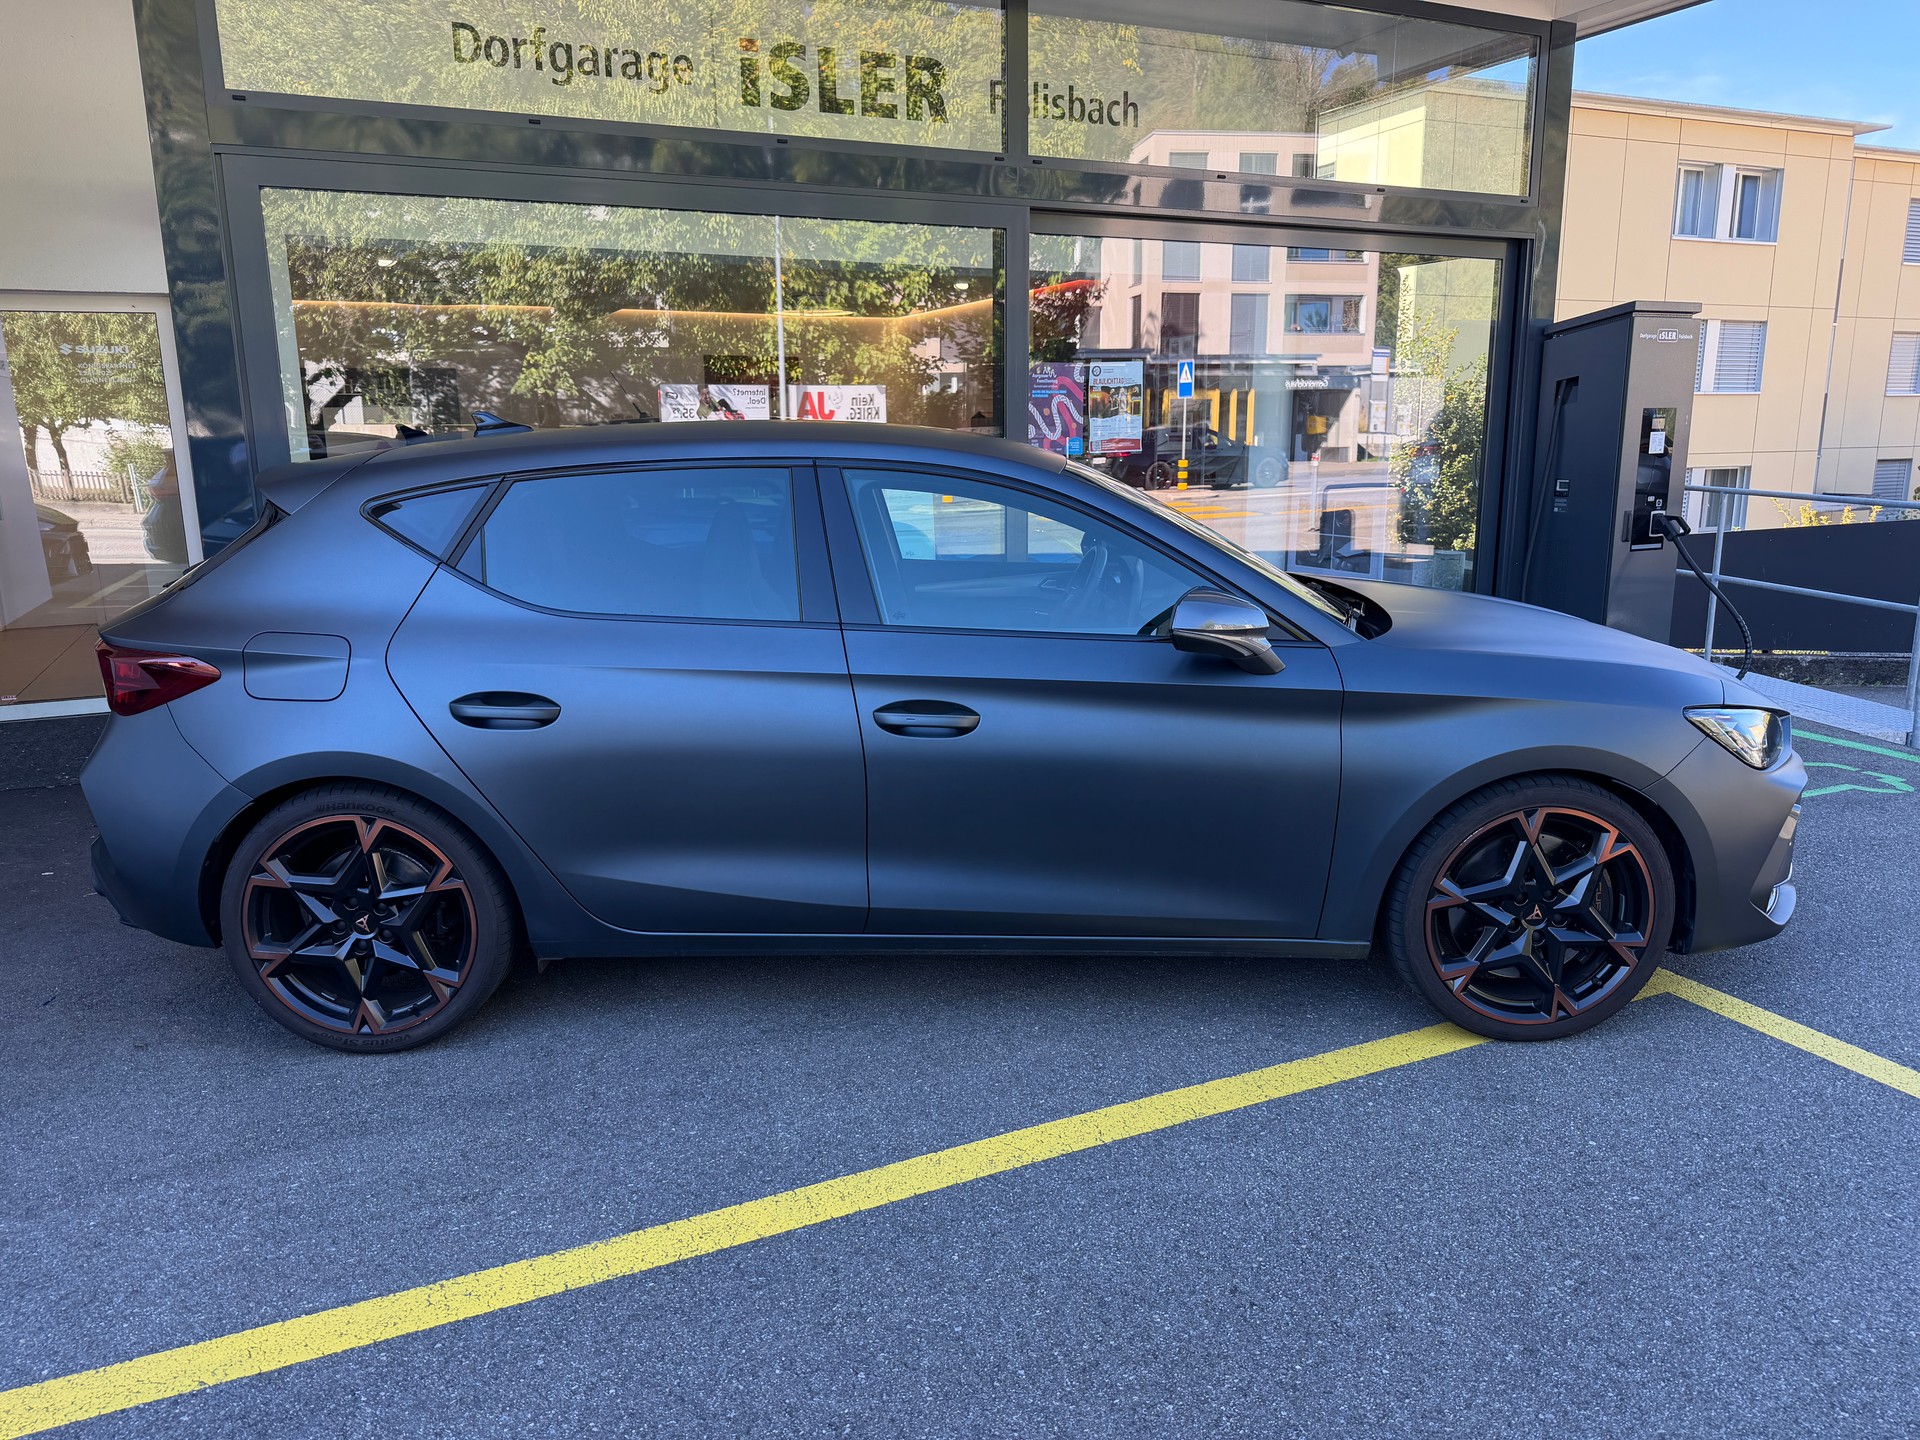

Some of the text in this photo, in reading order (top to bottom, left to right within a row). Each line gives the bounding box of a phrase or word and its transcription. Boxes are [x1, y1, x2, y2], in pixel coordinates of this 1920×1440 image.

[451, 21, 693, 94] Dorfgarage
[990, 79, 1139, 128] Flisbach
[75, 344, 129, 354] SUZUKI
